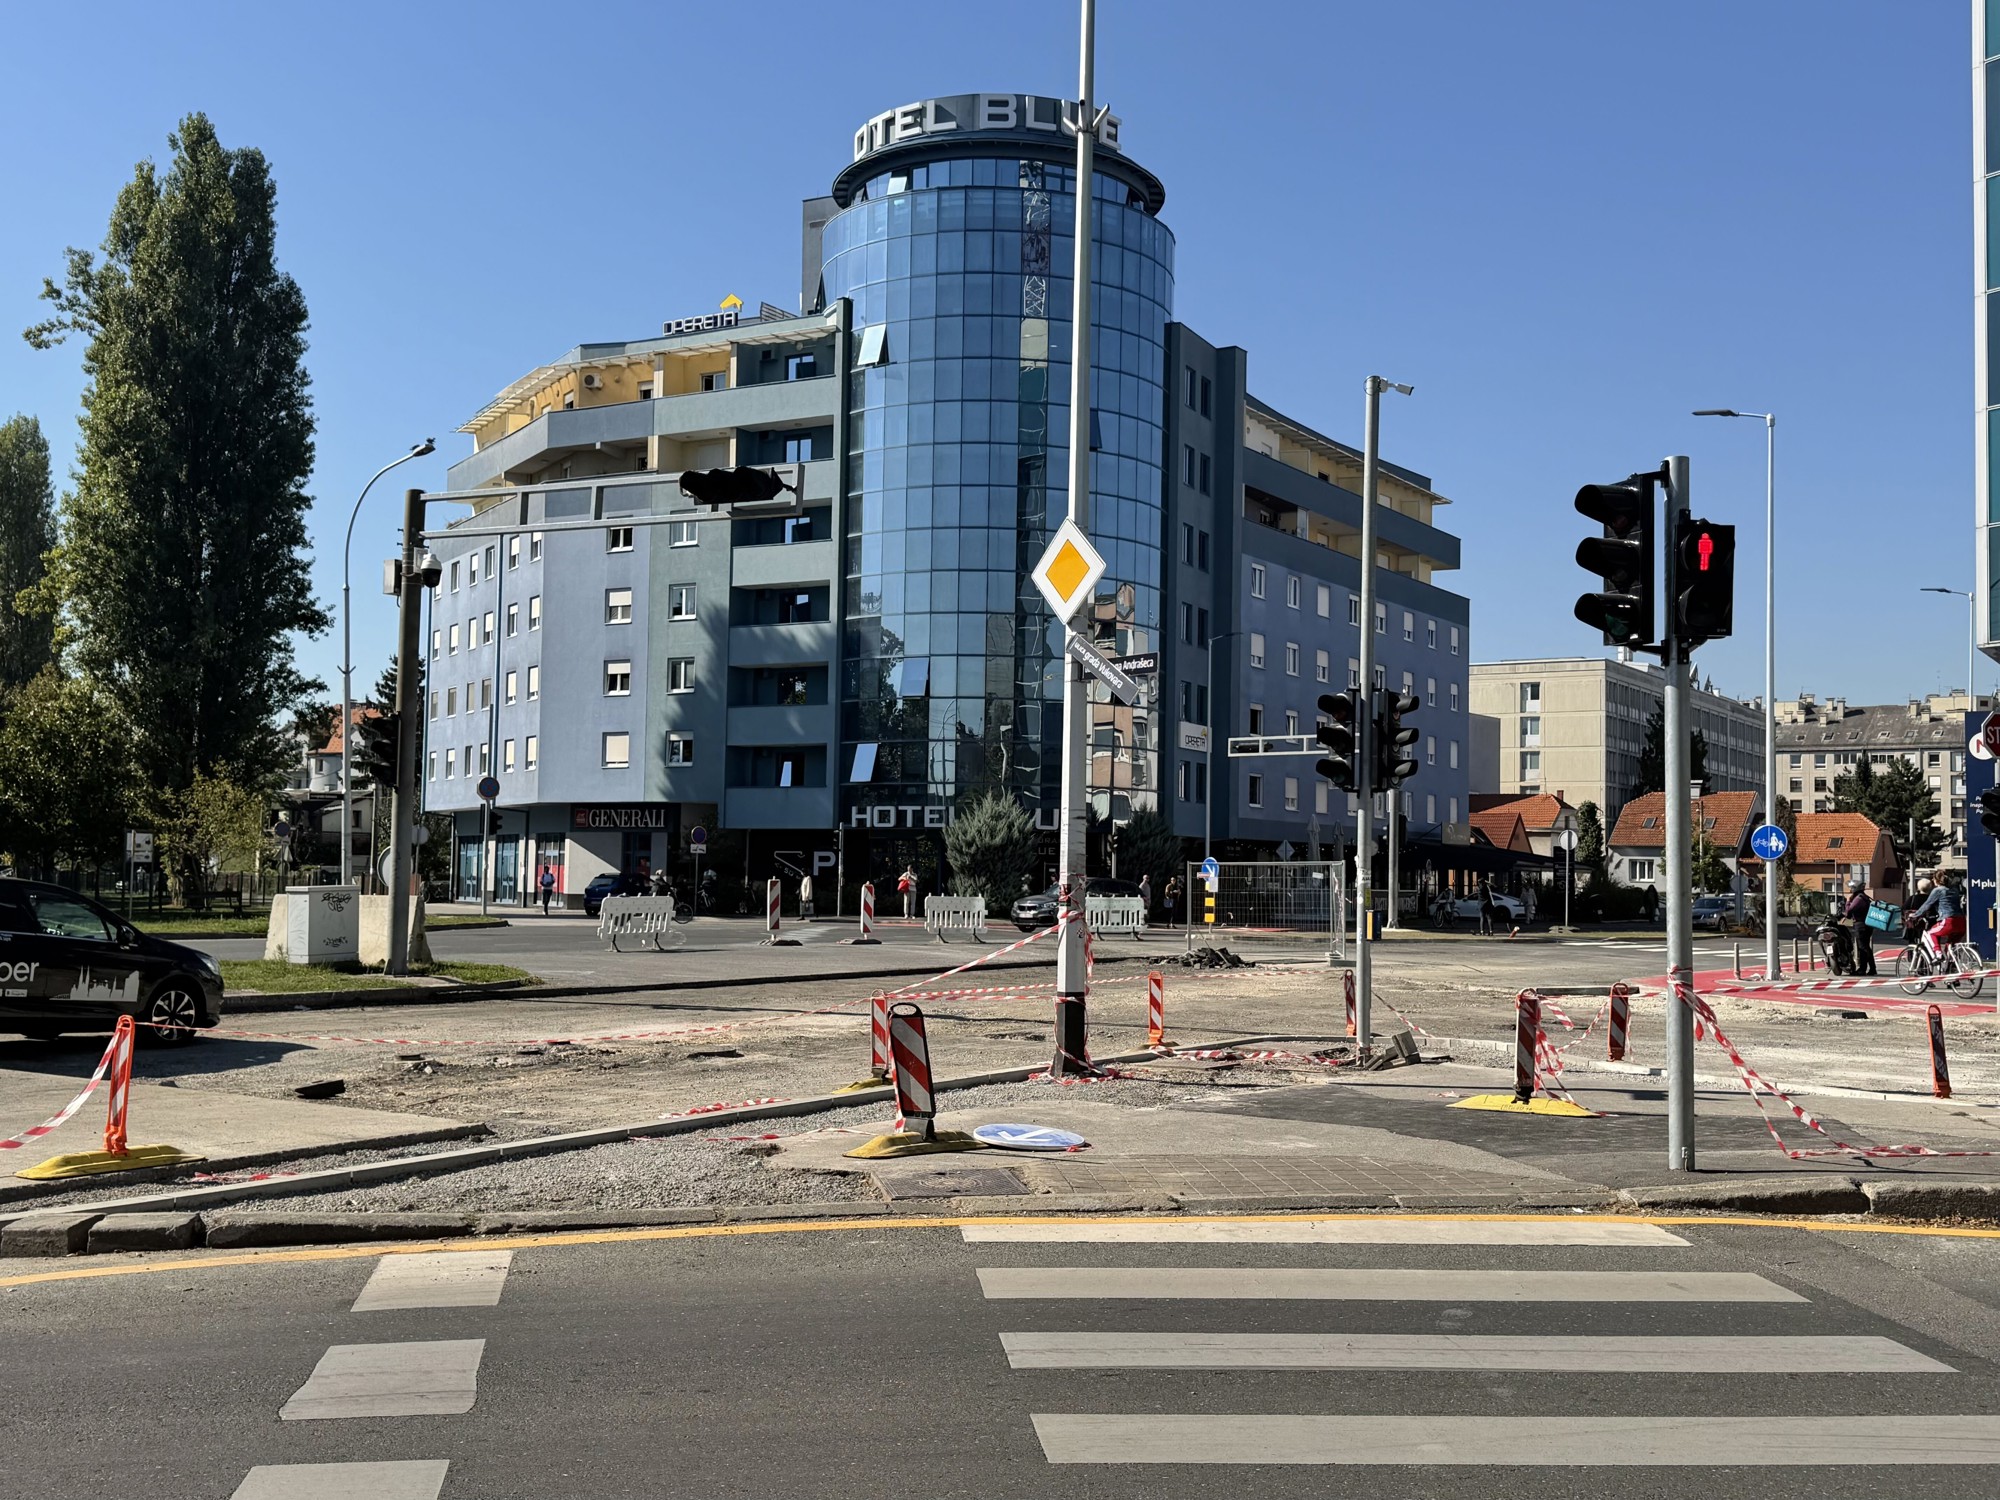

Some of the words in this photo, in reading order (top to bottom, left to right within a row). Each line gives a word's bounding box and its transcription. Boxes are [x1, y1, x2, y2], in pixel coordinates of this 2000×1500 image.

[662, 310, 736, 336] OPERETA
[1082, 651, 1101, 669] grada
[1098, 662, 1123, 689] Vukovara
[1122, 657, 1154, 671] Andrašeca
[589, 808, 666, 828] GENERALI
[813, 850, 836, 876] P
